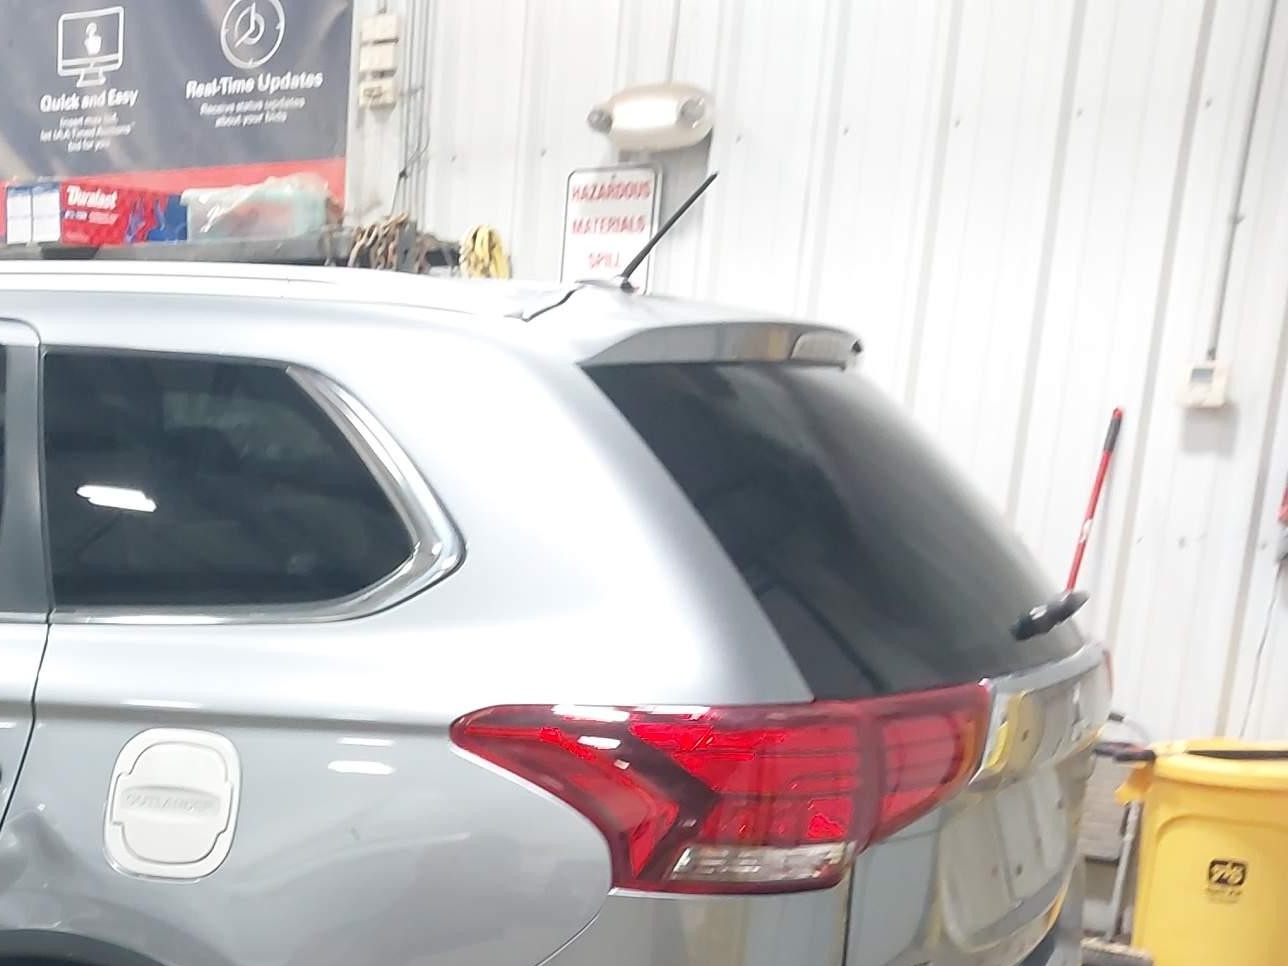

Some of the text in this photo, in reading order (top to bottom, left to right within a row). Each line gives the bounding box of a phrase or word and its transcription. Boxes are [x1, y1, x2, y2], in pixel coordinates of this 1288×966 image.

[185, 71, 323, 99] Real-Time Updates
[39, 88, 139, 113] Quick and Easy
[572, 180, 651, 202] HAZARDOUS
[572, 215, 648, 234] MATERIALS
